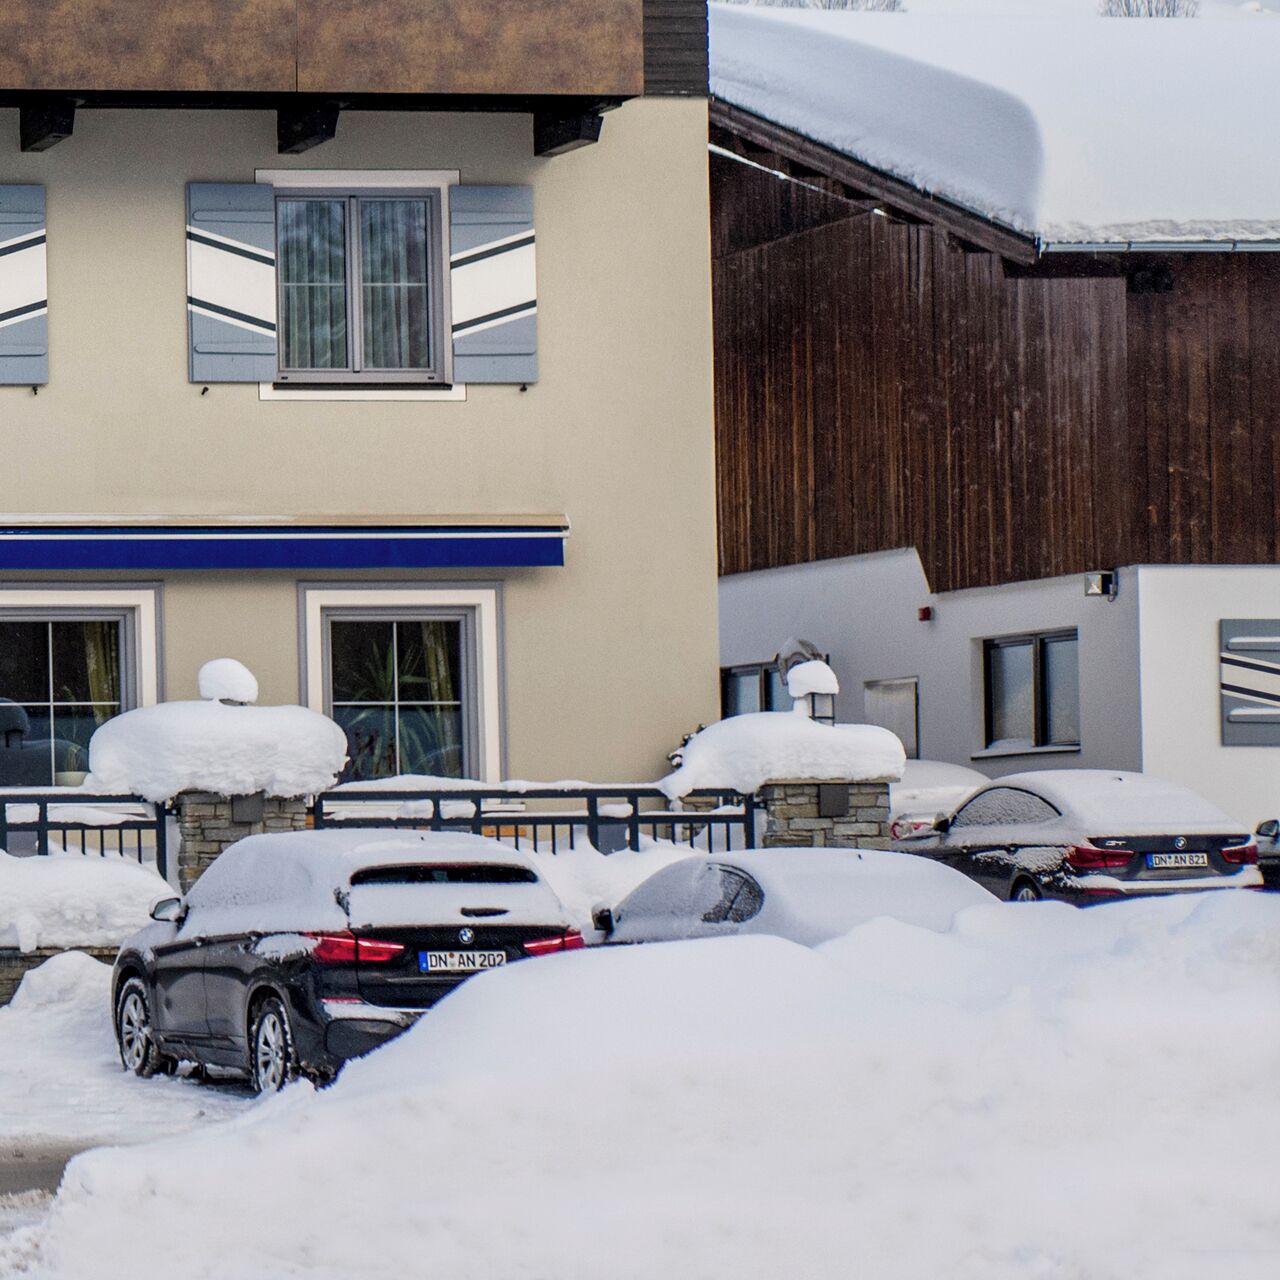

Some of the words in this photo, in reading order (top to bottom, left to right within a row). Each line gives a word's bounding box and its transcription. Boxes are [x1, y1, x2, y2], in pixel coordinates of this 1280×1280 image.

[429, 953, 448, 968] DN
[458, 953, 476, 967] AN
[479, 953, 504, 967] 202
